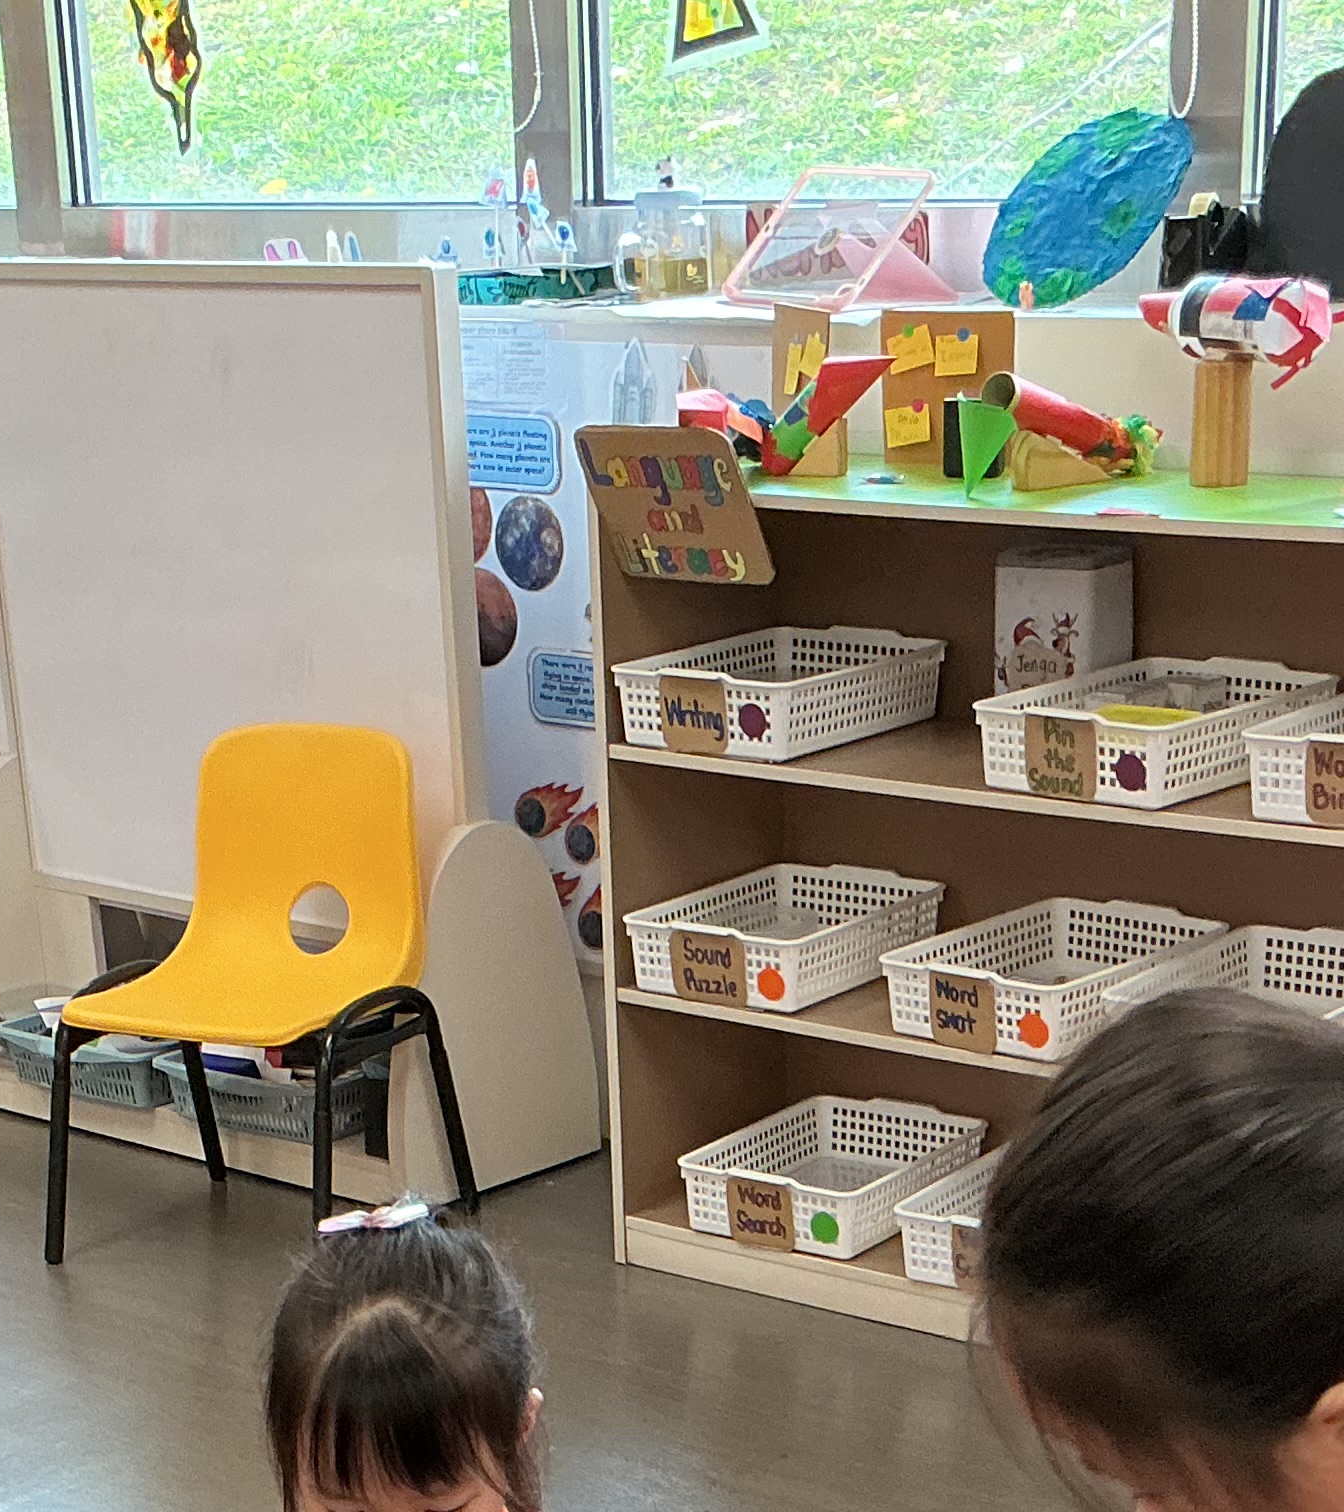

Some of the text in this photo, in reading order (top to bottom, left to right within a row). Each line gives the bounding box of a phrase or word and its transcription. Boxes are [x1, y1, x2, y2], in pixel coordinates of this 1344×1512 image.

[578, 438, 733, 507] Language
[647, 504, 704, 535] and
[615, 531, 746, 582] Literacy
[1016, 655, 1058, 684] Jenga
[664, 696, 725, 742] Writing
[1043, 716, 1075, 750] Pin
[1043, 747, 1076, 775] the
[1028, 766, 1084, 797] Sound
[683, 936, 733, 970] Sound
[683, 967, 738, 998] Puzzle
[935, 977, 979, 1008] Word
[737, 1183, 782, 1212] Word
[736, 1208, 787, 1241] Search
